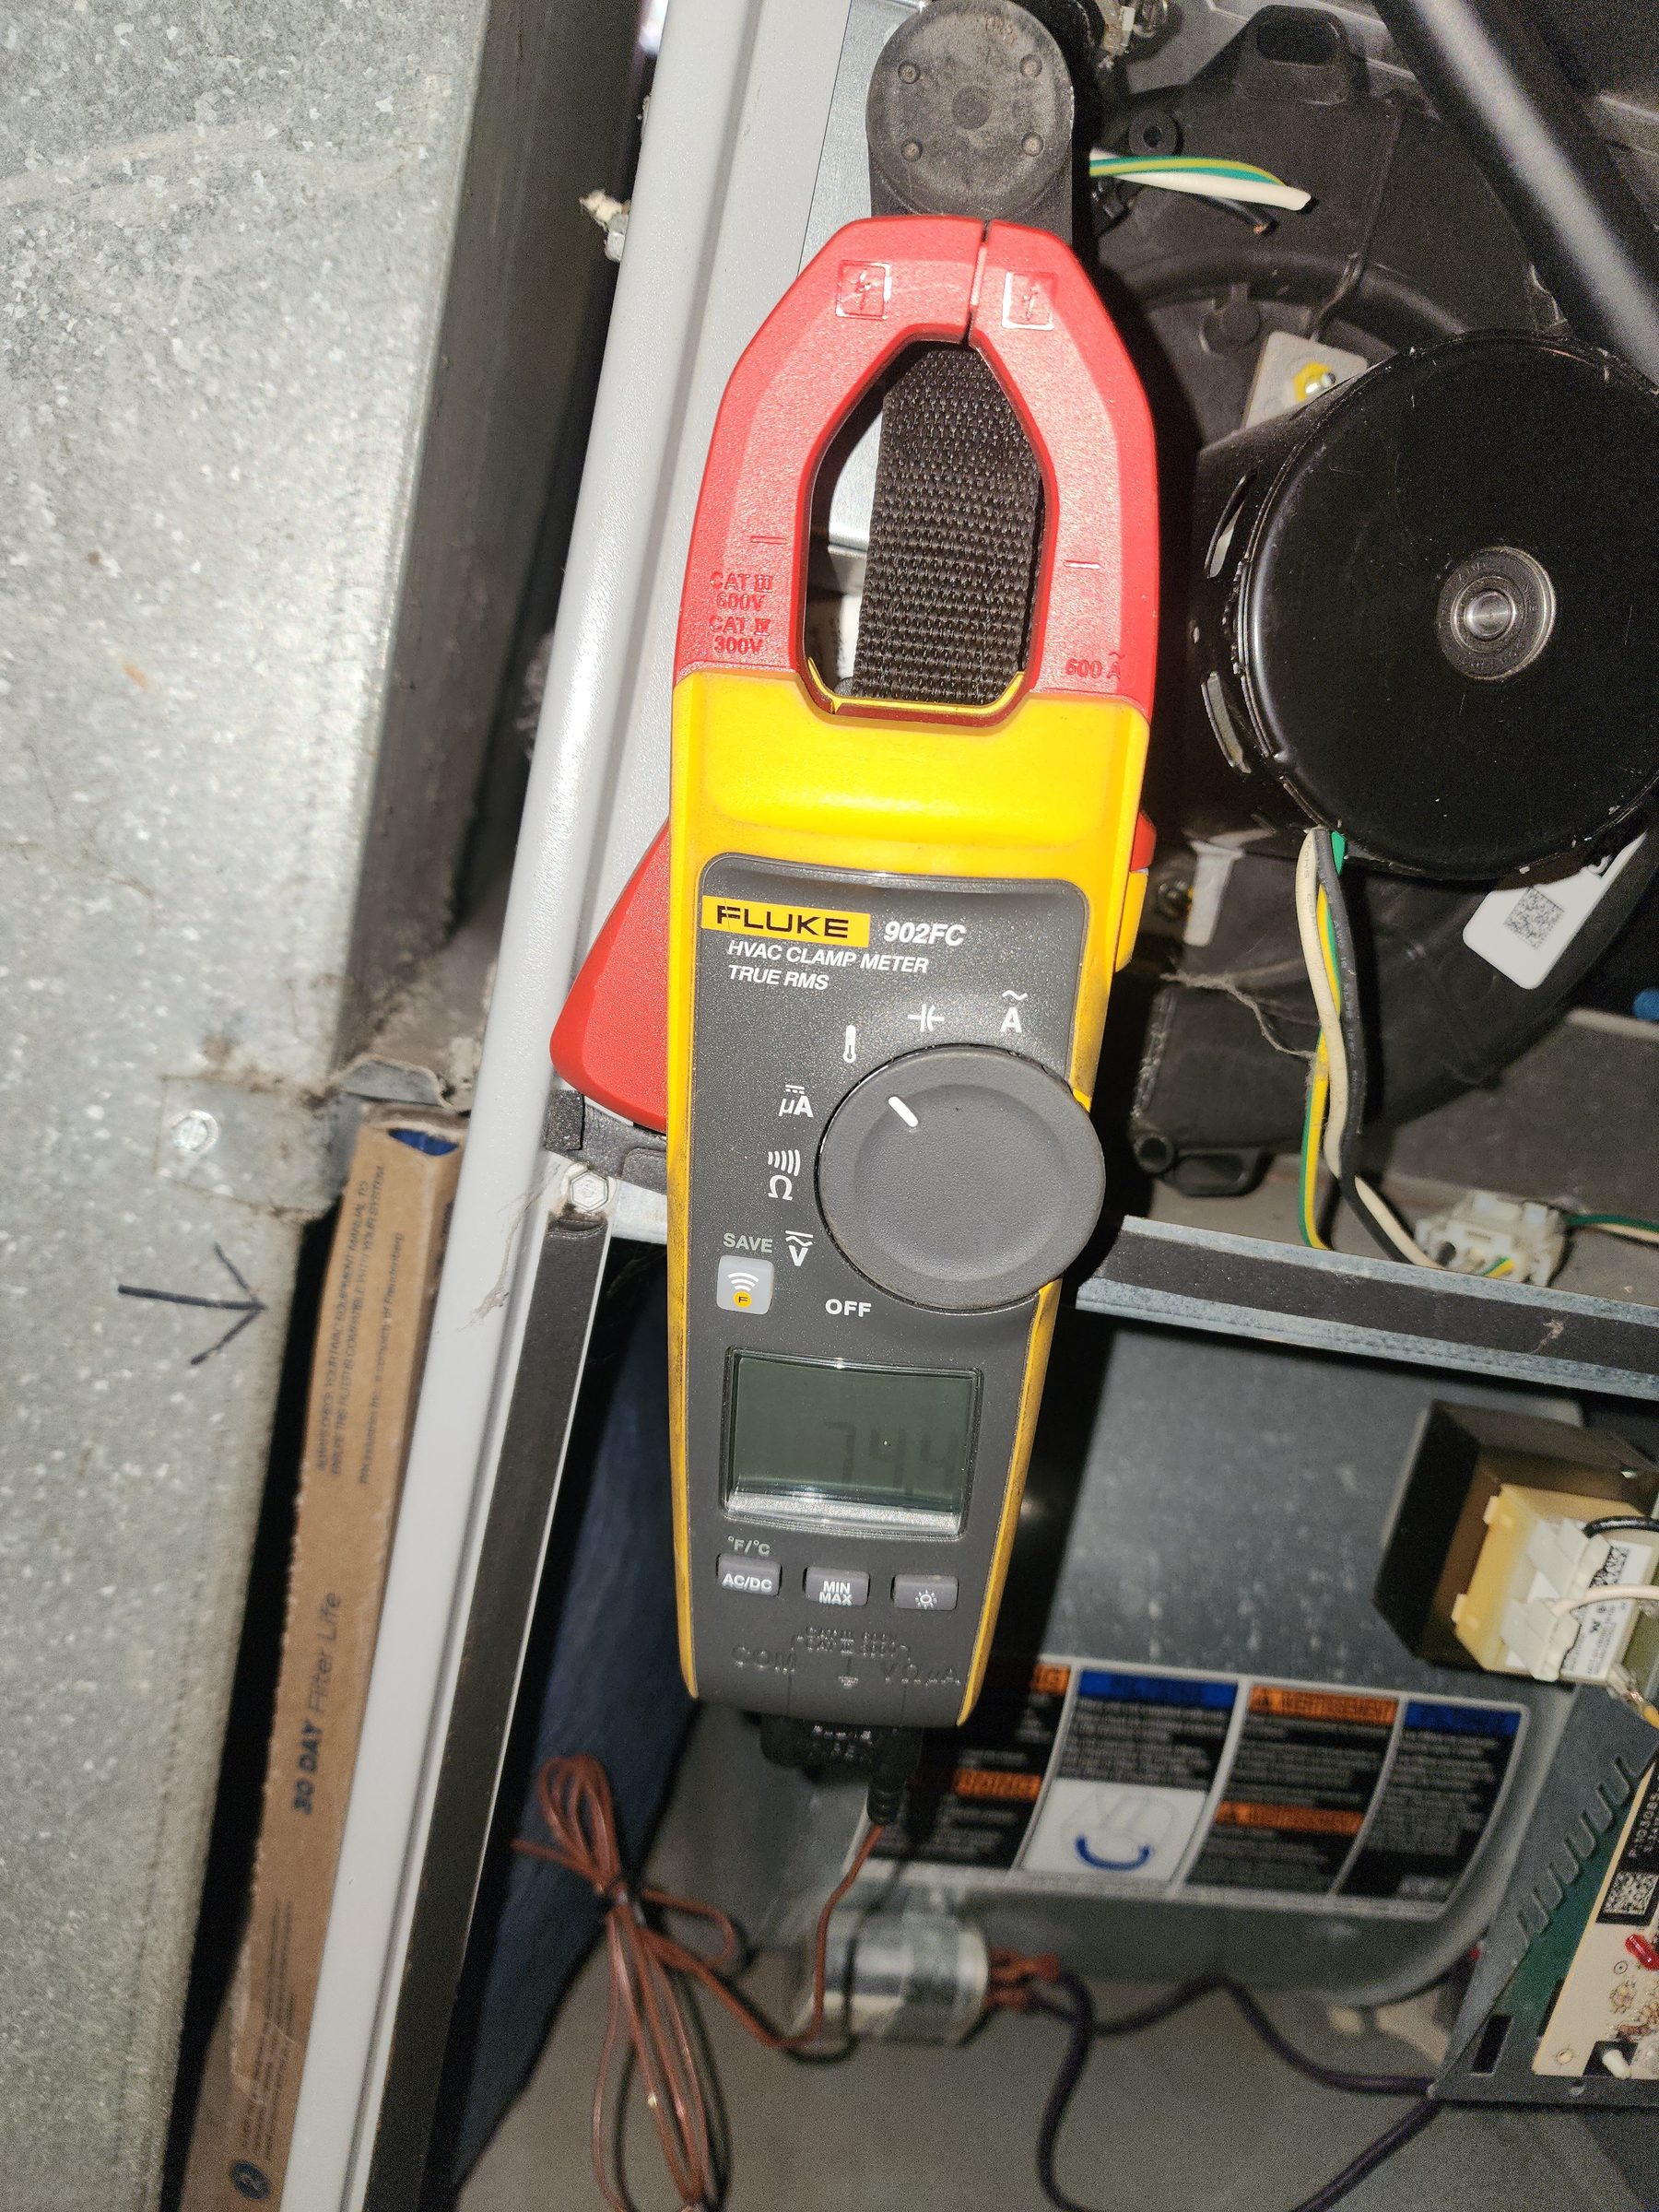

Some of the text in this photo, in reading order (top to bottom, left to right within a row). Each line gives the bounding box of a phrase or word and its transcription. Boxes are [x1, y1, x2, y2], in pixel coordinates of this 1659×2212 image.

[710, 571, 750, 591] CAT
[716, 592, 766, 611] 600V
[710, 615, 748, 634] CAT
[714, 635, 763, 654] 300V
[1065, 658, 1102, 679] 600
[717, 904, 967, 947] FLUKE 902FC
[728, 939, 929, 974] HVAC CLAMP METER
[728, 964, 830, 991] TRUE RMS
[349, 1200, 365, 1252] MANUAL
[359, 1180, 368, 1197] TO
[723, 1232, 773, 1253] SAVE
[825, 1298, 872, 1318] OFF
[722, 1572, 772, 1594] AC/DC
[822, 1580, 851, 1595] MIN
[818, 1591, 853, 1606] MAX
[318, 1592, 341, 1642] Life
[732, 1645, 796, 1674] COM
[308, 1647, 333, 1712] Filter
[299, 1720, 321, 1774] DAY
